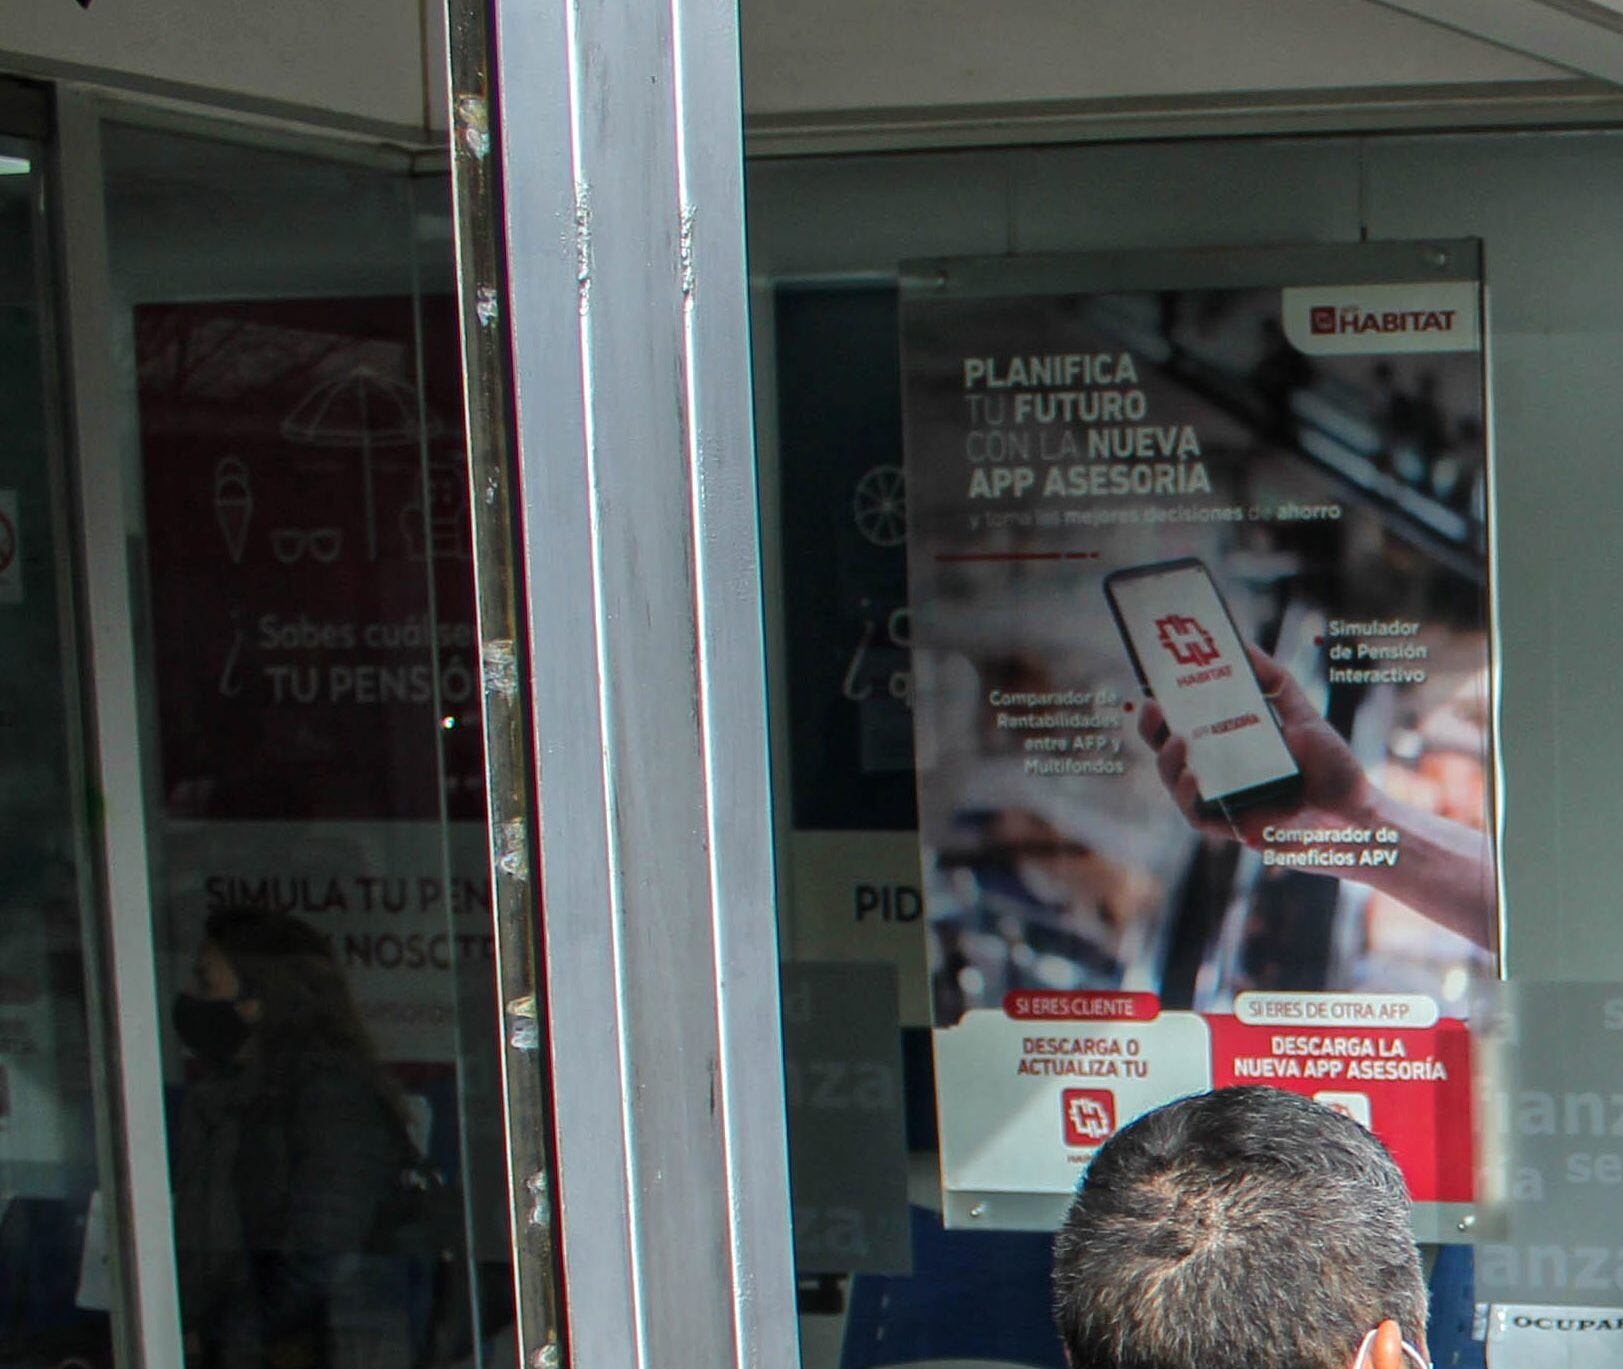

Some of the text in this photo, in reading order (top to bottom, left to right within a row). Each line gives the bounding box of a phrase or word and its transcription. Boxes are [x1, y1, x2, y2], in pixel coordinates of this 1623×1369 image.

[1340, 310, 1456, 334] HABITAT
[964, 352, 1139, 389] PLANIFICA
[966, 390, 1147, 425] TU FUTURO
[966, 425, 1201, 462] CON LA NUEVA
[968, 452, 1211, 499] APP ASESORÍA
[1065, 508, 1139, 528] mejores
[1277, 502, 1342, 520] ahorro
[1330, 620, 1420, 637] Simulador
[1330, 643, 1428, 660] de Pensión
[263, 654, 474, 703] TU PENSÓ
[1330, 668, 1427, 683] Interactivo
[990, 690, 1091, 707] Comparador
[997, 714, 1119, 730] Rentabilidades
[1024, 736, 1121, 753] entre AFP y
[1024, 759, 1125, 774] Multifondos
[1263, 826, 1399, 844] Comparador de
[1263, 849, 1399, 866] Beneficios APV
[207, 876, 491, 913] SIMULA TU PEN
[856, 886, 922, 922] PID
[1016, 998, 1134, 1016] SI ERES CLIENTE
[1250, 1002, 1410, 1020] SI ERES DE OTRA AFP
[1023, 1038, 1139, 1056] DESCARGA O
[1271, 1037, 1406, 1058] DESCARGA LA
[1018, 1059, 1148, 1078] ACTUALIZA TU
[1234, 1055, 1448, 1080] NUEVA APP ASESORÍA
